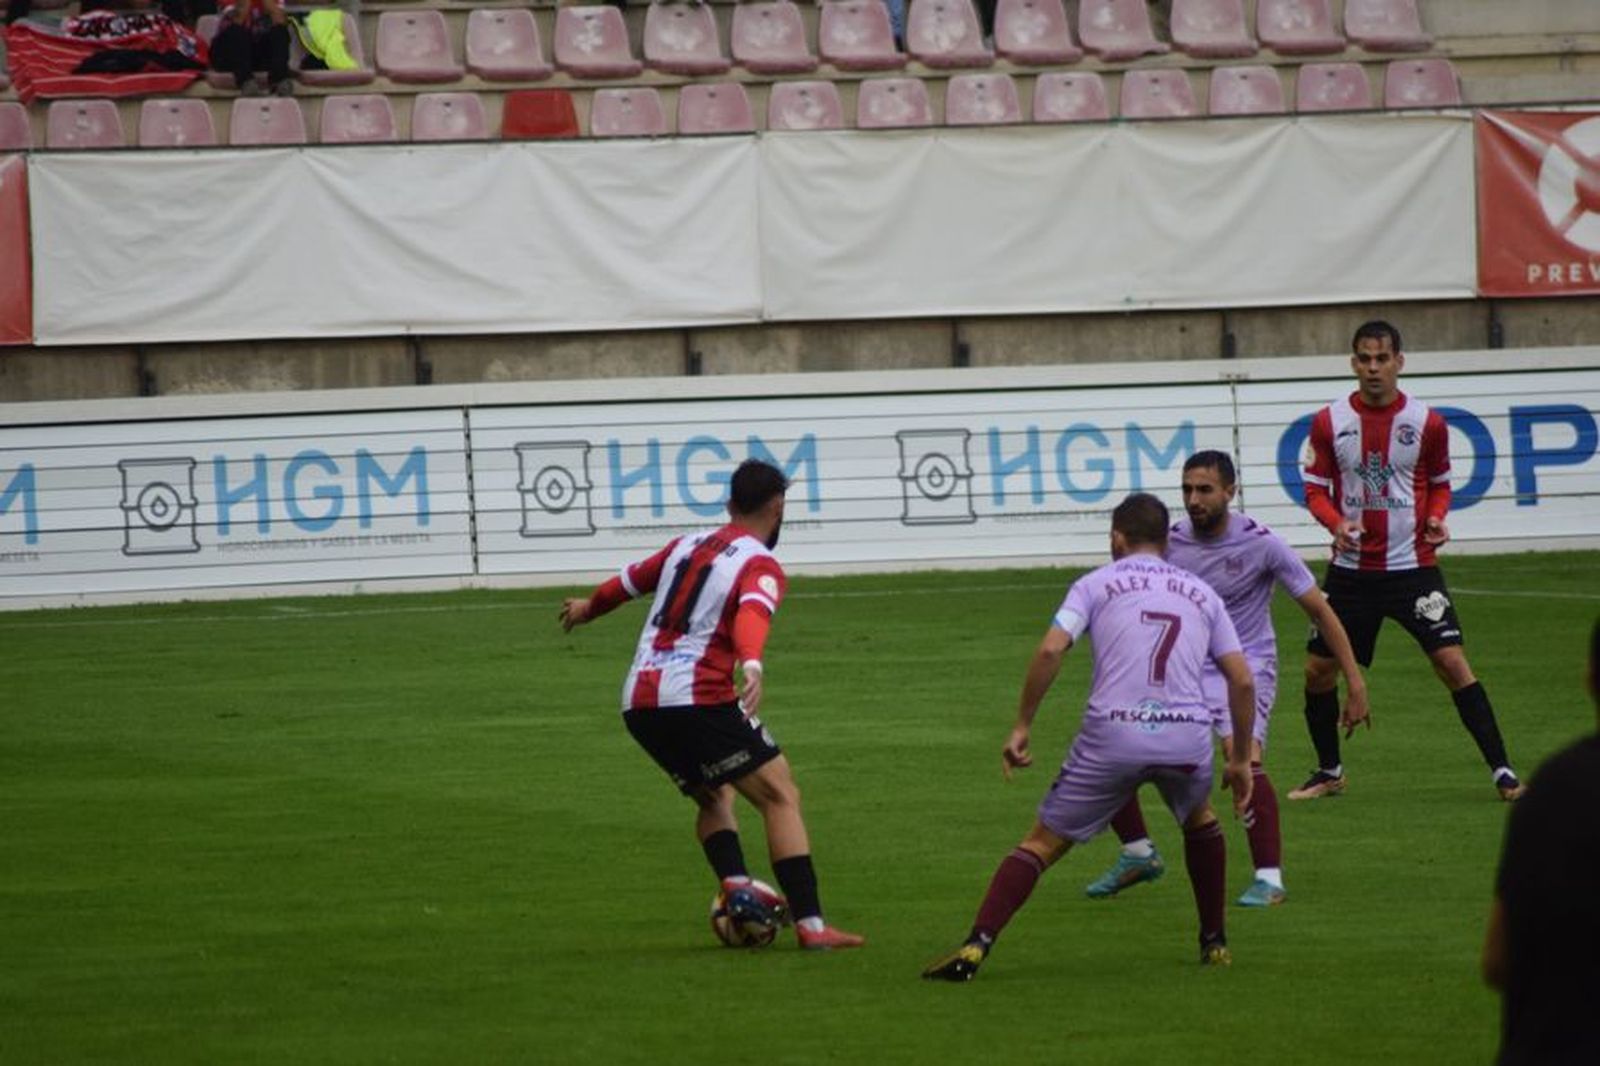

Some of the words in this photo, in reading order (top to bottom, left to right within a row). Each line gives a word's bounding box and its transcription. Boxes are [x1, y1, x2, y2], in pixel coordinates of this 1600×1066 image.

[212, 445, 430, 536] HGM
[607, 433, 820, 519] HGM
[988, 420, 1196, 506] HGM
[652, 556, 714, 635] 11
[1105, 576, 1153, 601] ALEX
[1167, 579, 1207, 606] GLEZ
[1141, 611, 1181, 687] 7
[1110, 709, 1195, 723] PESCAMAR
